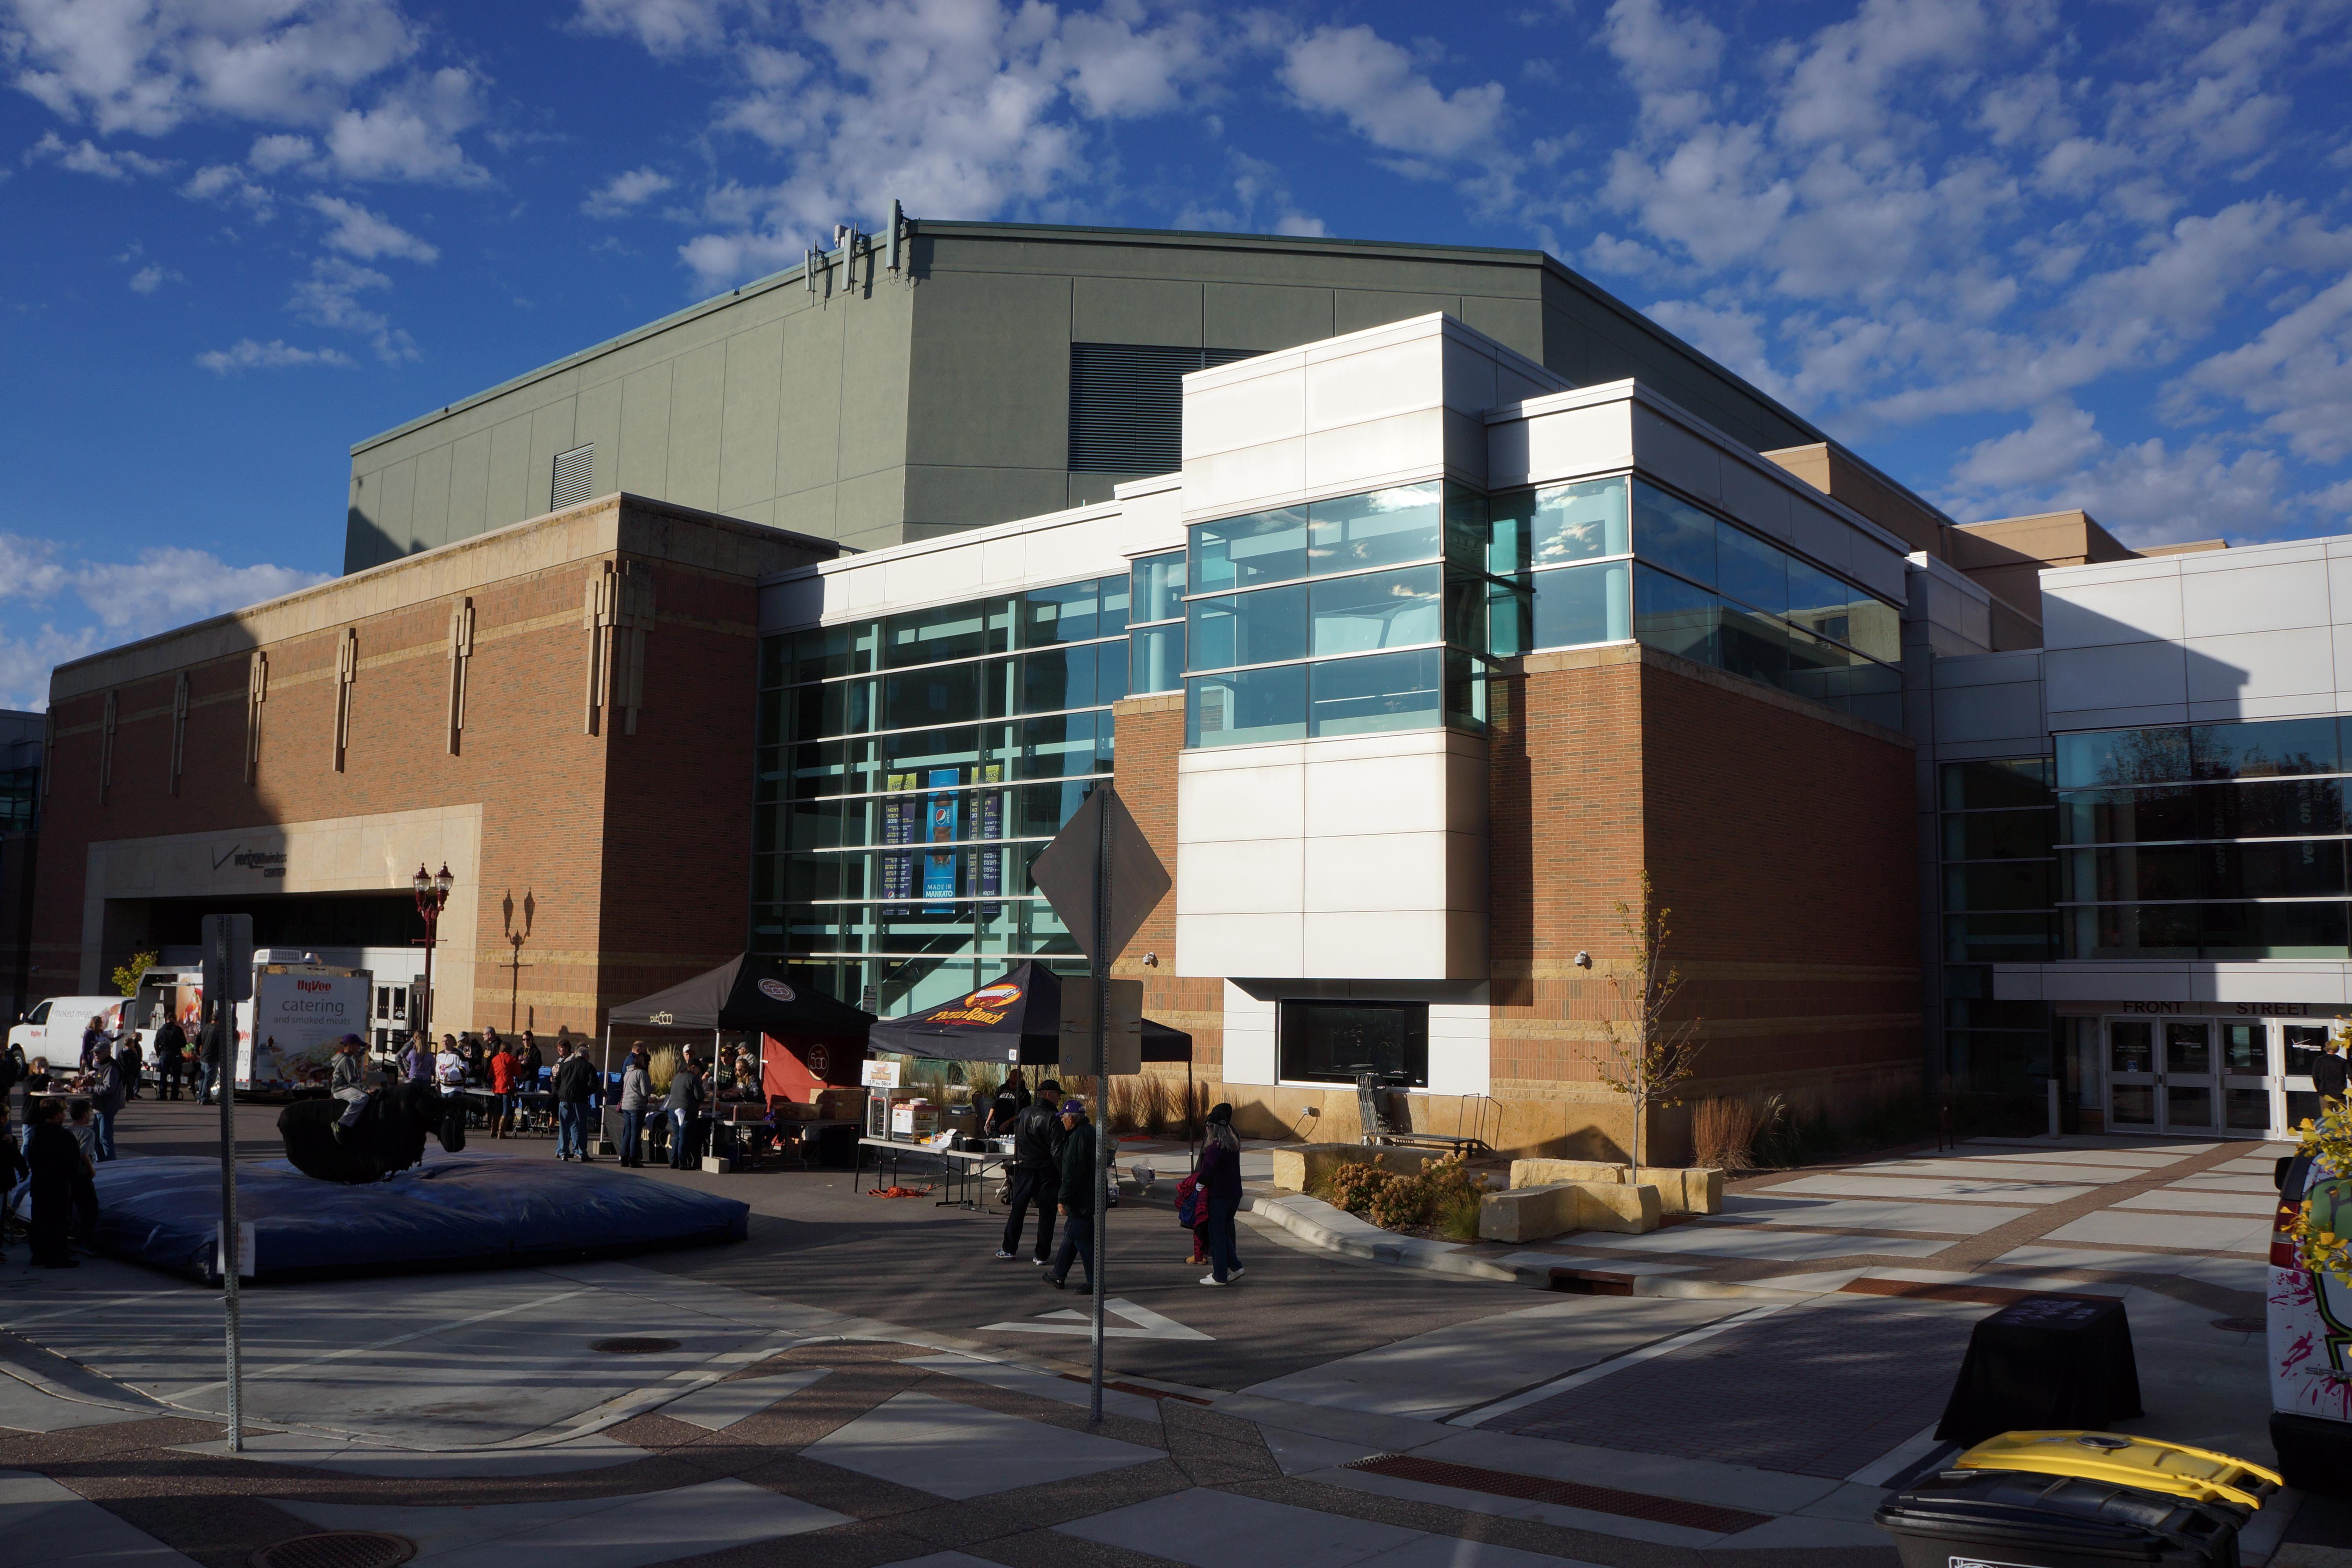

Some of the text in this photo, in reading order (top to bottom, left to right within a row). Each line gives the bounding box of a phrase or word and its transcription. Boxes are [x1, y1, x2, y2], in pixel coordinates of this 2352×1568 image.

[298, 980, 331, 993] HyVee
[763, 985, 789, 995] 500
[51, 1008, 94, 1018] smoked meats
[282, 999, 344, 1016] catering
[2123, 1001, 2311, 1015] FRONT STREET
[291, 1016, 324, 1024] smoked
[926, 1007, 1007, 1025] Pizza Ranch
[810, 1053, 827, 1070] 500
